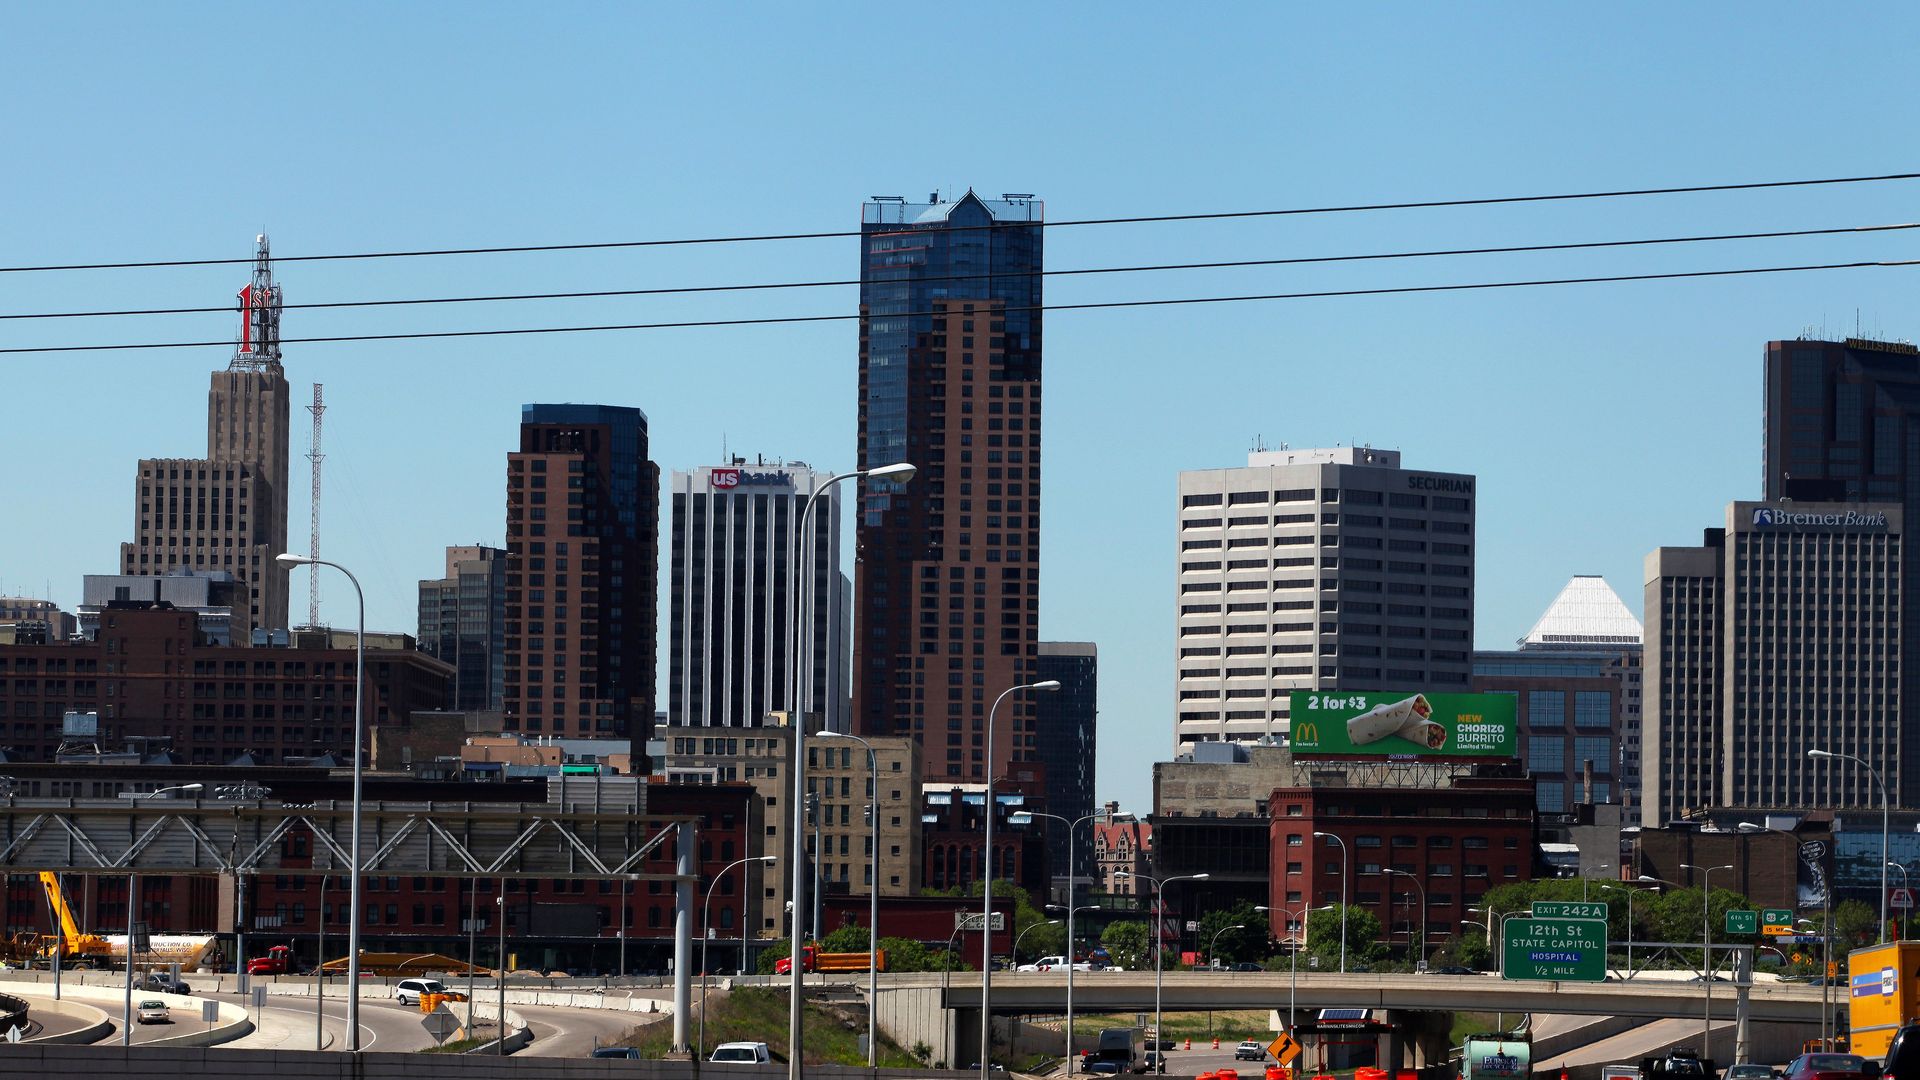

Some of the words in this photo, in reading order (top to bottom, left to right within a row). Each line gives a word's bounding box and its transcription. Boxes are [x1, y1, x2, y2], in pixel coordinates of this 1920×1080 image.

[238, 282, 271, 353] 1st
[1848, 339, 1884, 351] WELLS
[1885, 343, 1918, 356] FARGO
[739, 469, 789, 485] bank
[1408, 476, 1472, 493] SECURIAN
[1773, 508, 1843, 526] Bremer
[1843, 510, 1886, 526] Bank
[1308, 696, 1319, 710] 2
[1323, 696, 1346, 710] for
[1349, 696, 1367, 710] $3
[1457, 714, 1482, 723] NEW
[1457, 724, 1505, 733] CHORIZO
[1457, 734, 1505, 743] BURRITO
[1537, 906, 1557, 914] EXIT
[1529, 925, 1559, 936] 12th
[1567, 925, 1582, 937] St
[1512, 939, 1546, 948] STATE
[1551, 940, 1599, 949] CAPITOL
[1532, 953, 1578, 961] HOSPITAL
[1535, 966, 1548, 976] 1/2
[1553, 967, 1575, 975] MILE
